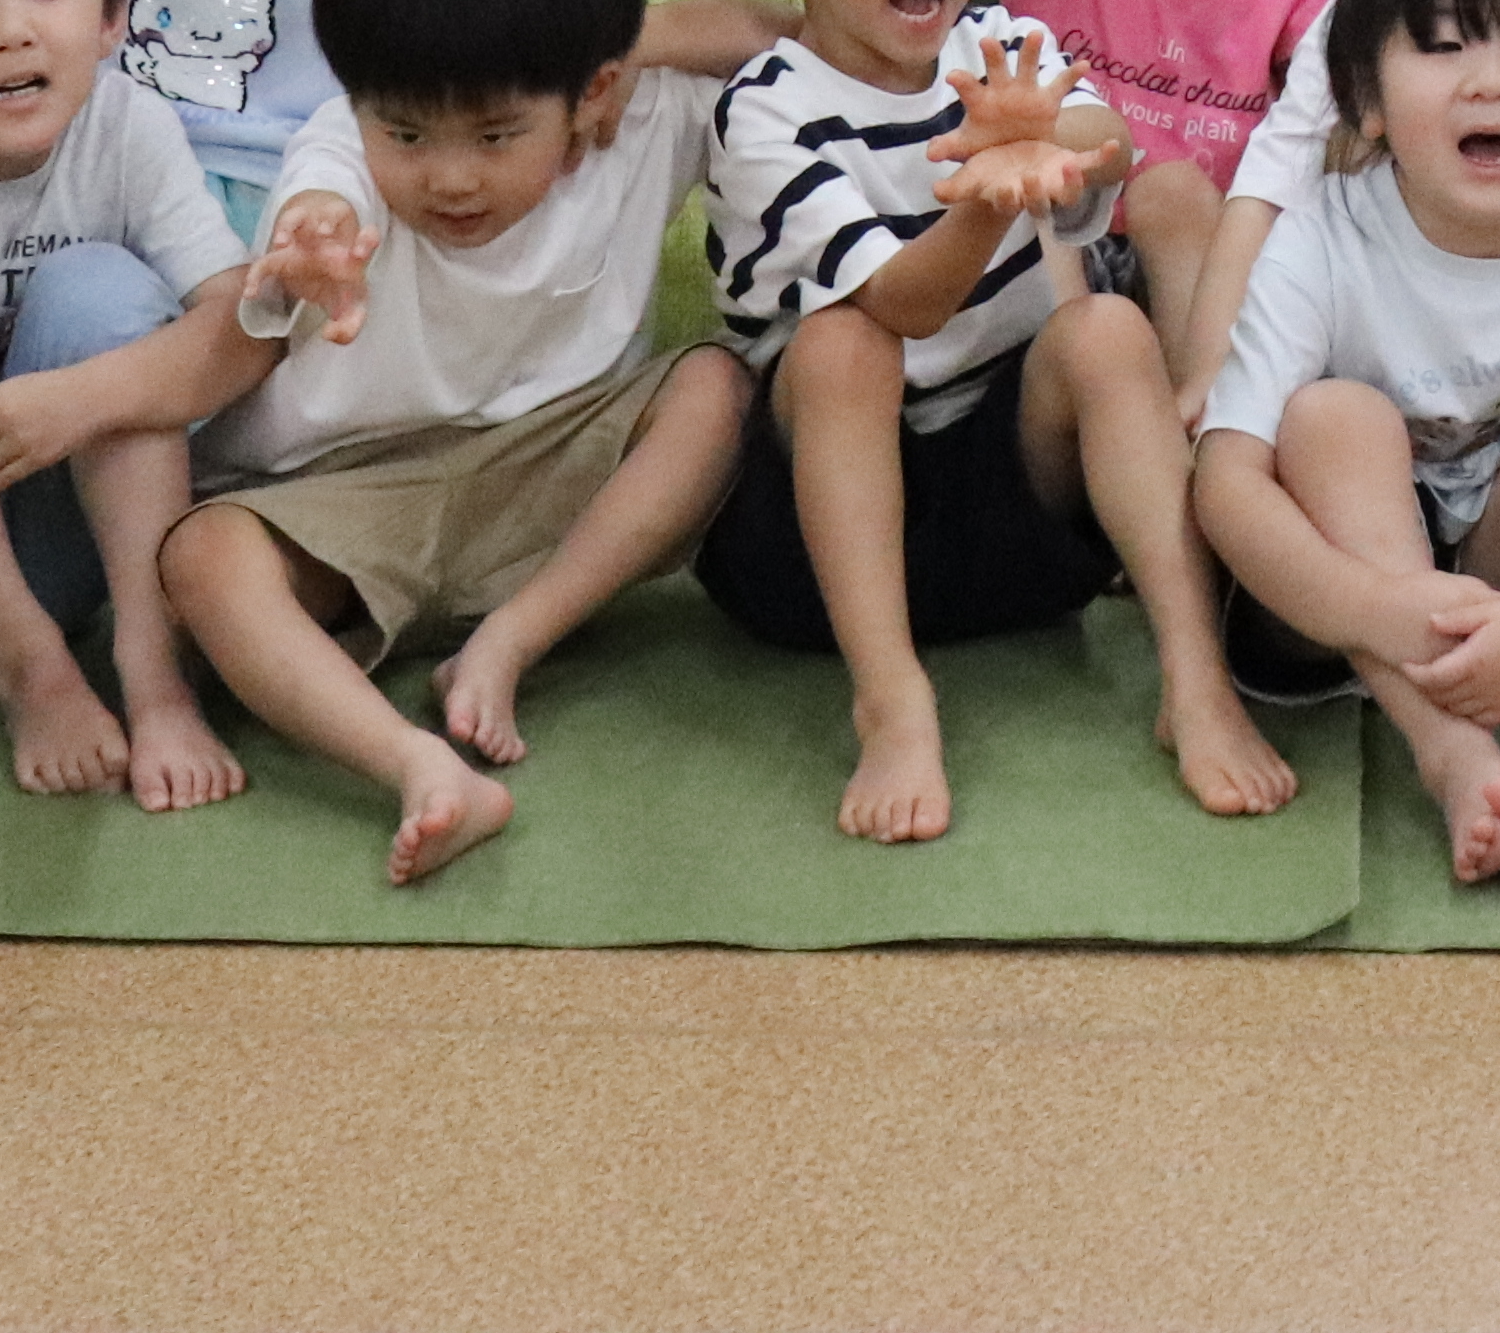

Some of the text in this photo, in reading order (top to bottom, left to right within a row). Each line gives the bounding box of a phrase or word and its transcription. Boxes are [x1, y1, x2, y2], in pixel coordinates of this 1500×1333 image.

[1060, 29, 1180, 97] Chocolat
[1121, 100, 1175, 130] vous
[1184, 118, 1239, 143] plaît
